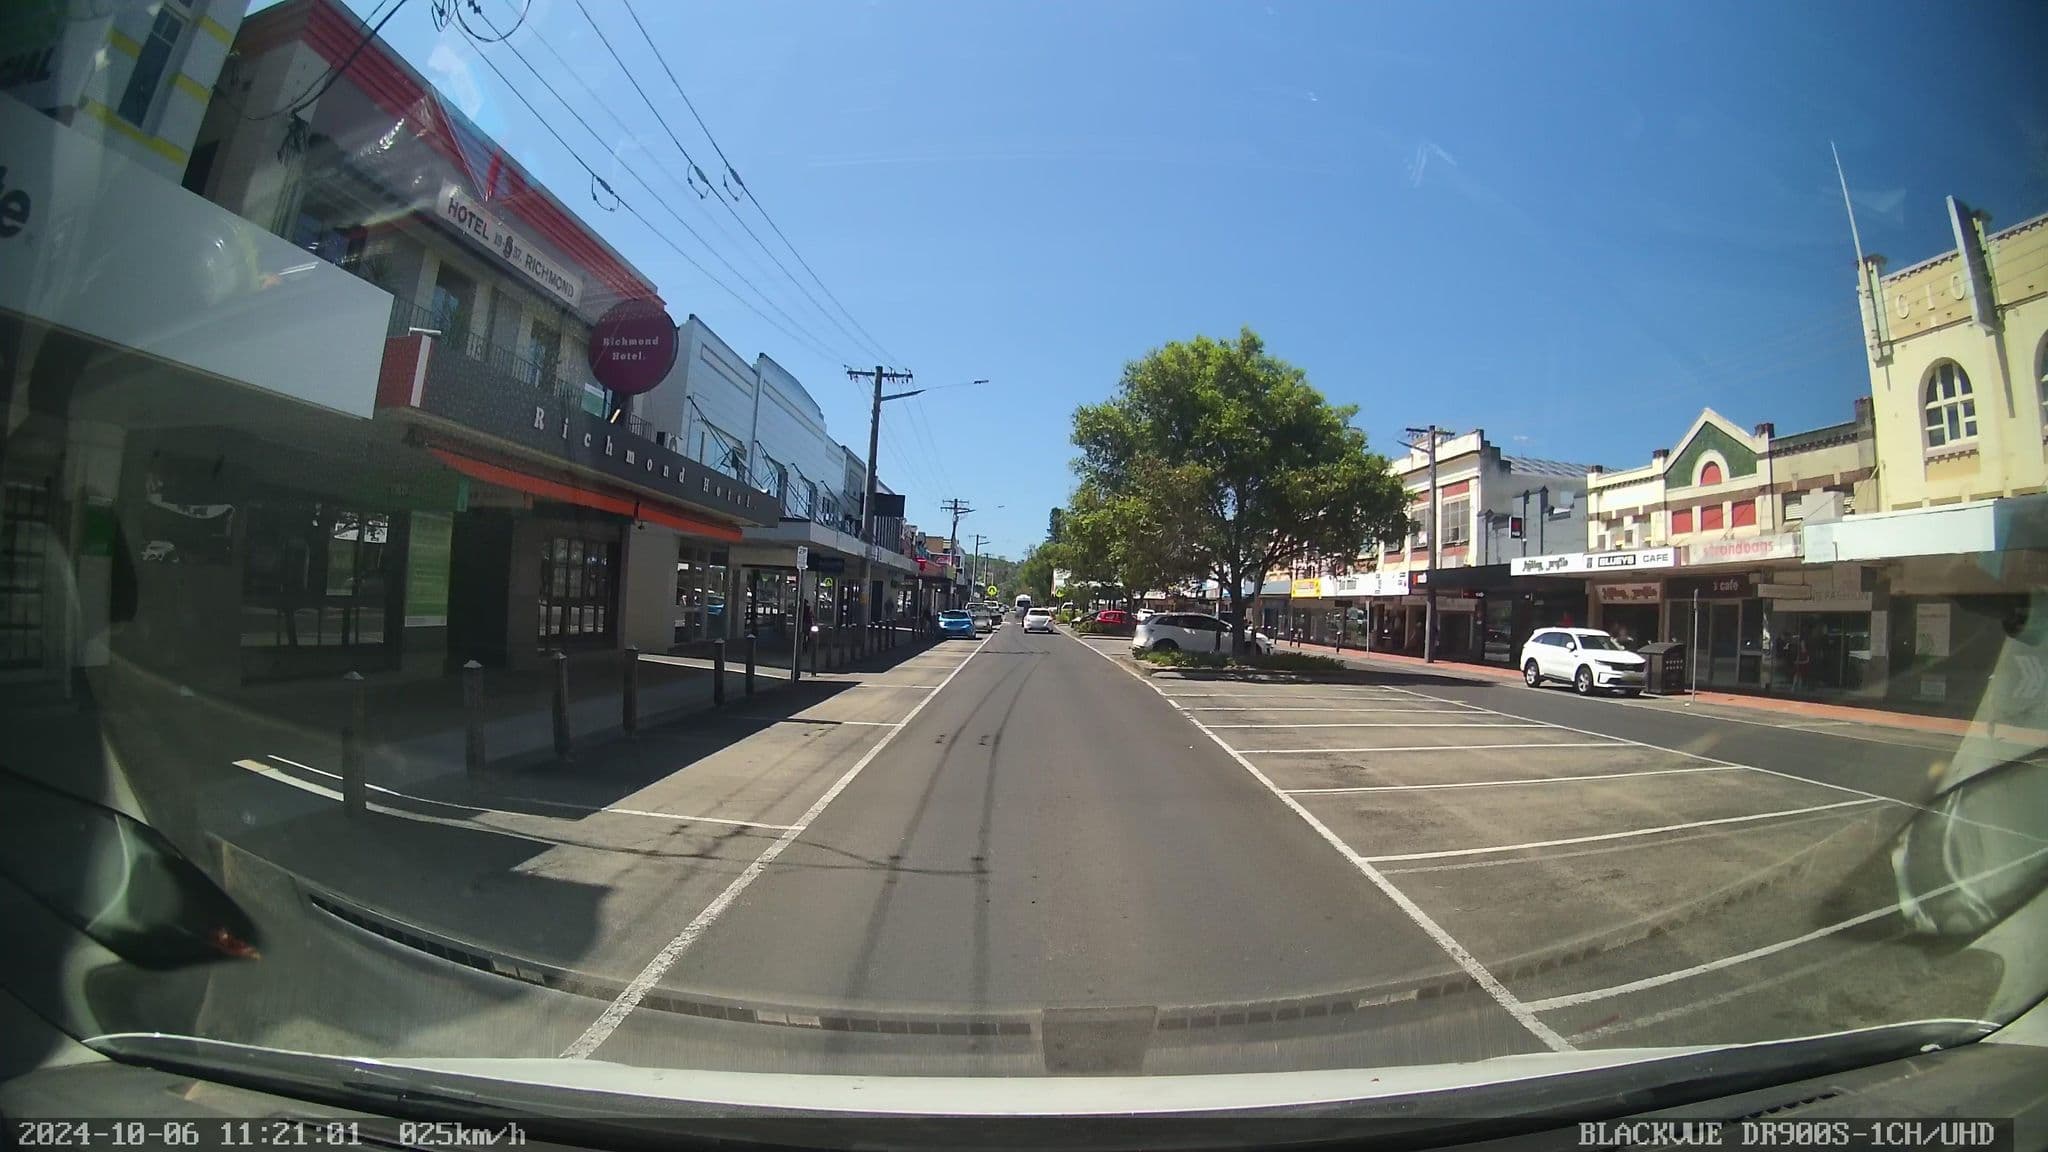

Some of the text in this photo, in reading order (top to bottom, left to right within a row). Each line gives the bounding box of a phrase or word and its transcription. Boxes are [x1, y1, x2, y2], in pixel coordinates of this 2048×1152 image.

[447, 197, 489, 241] HOTEL
[525, 253, 575, 298] RICHMOND
[602, 335, 660, 346] Richmond
[533, 405, 687, 485] Richmond
